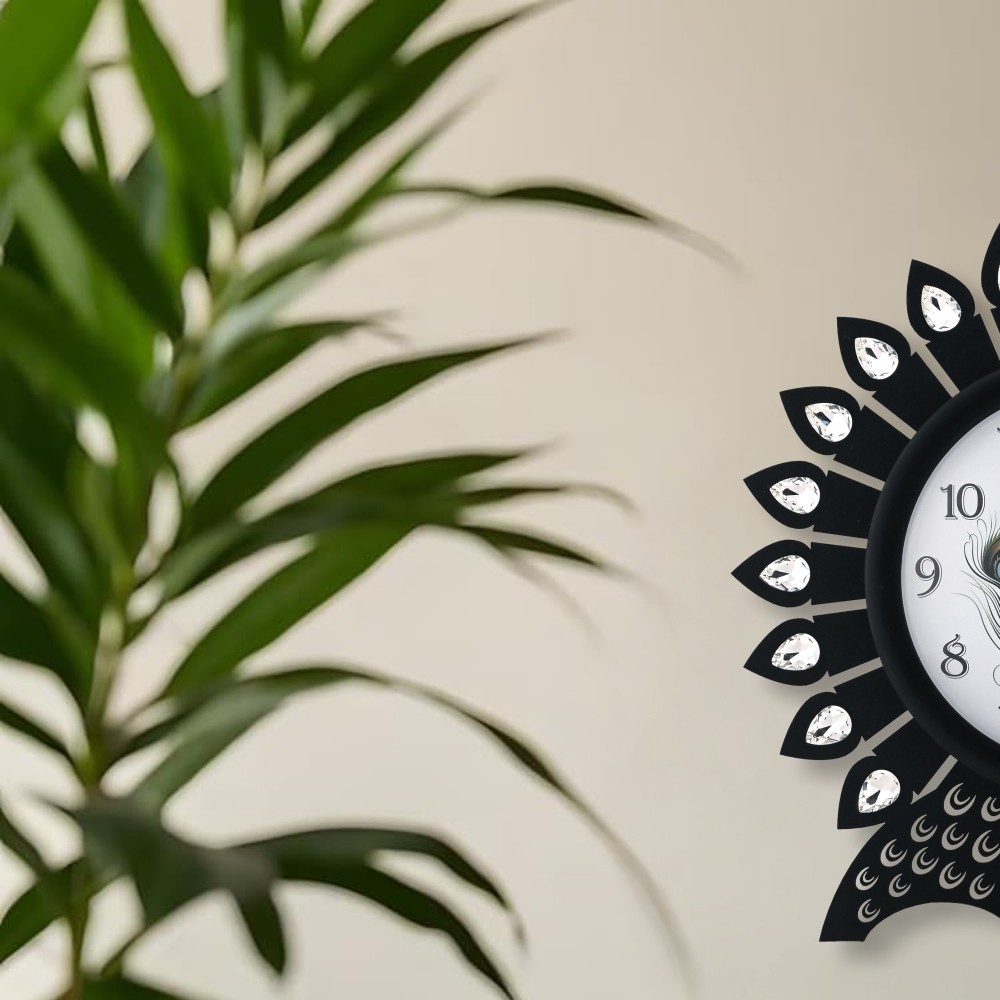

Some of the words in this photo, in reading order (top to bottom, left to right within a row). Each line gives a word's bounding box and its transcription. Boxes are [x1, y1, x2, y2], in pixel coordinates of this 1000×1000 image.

[940, 482, 986, 519] 10
[914, 556, 942, 598] 9
[940, 634, 969, 679] 8
